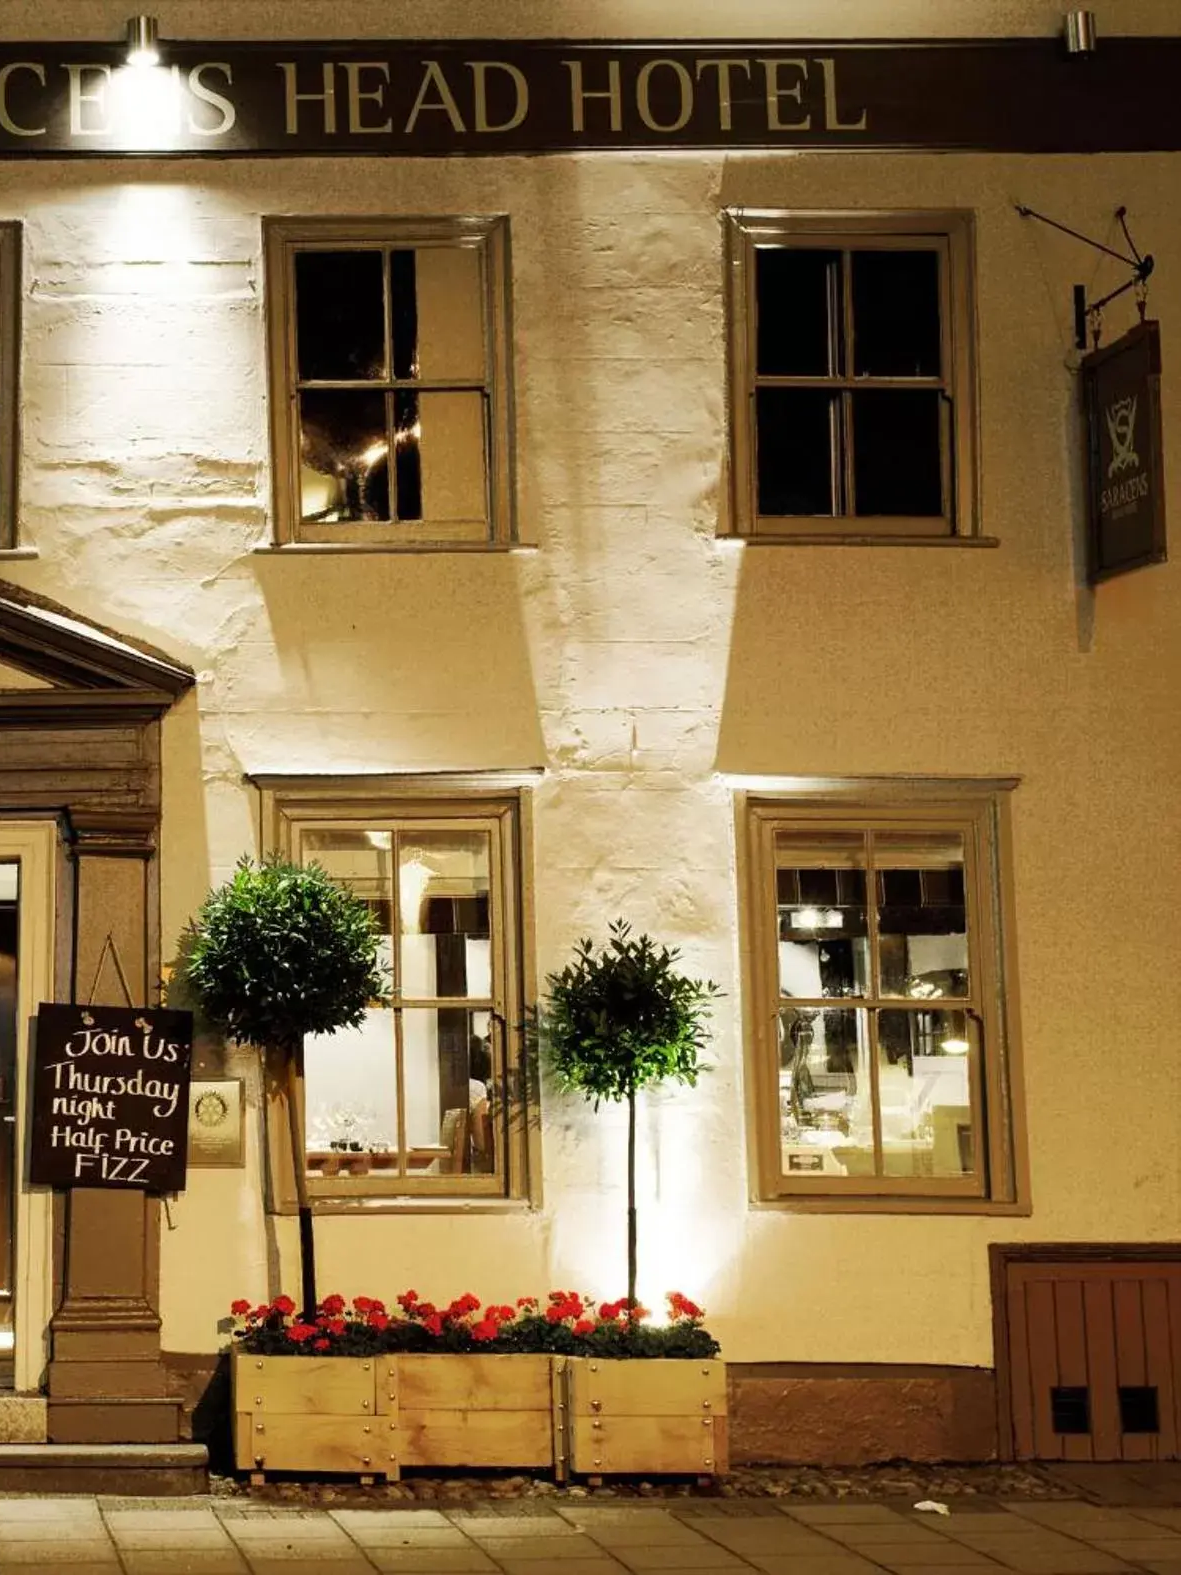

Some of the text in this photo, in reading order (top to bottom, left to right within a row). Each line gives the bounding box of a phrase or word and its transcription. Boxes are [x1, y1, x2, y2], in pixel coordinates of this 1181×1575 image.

[276, 60, 530, 135] HEAD
[560, 59, 868, 133] HOTEL
[65, 1028, 136, 1058] Join
[43, 1060, 180, 1118] Thursday
[52, 1094, 116, 1126] night
[50, 1125, 175, 1156] Half Price
